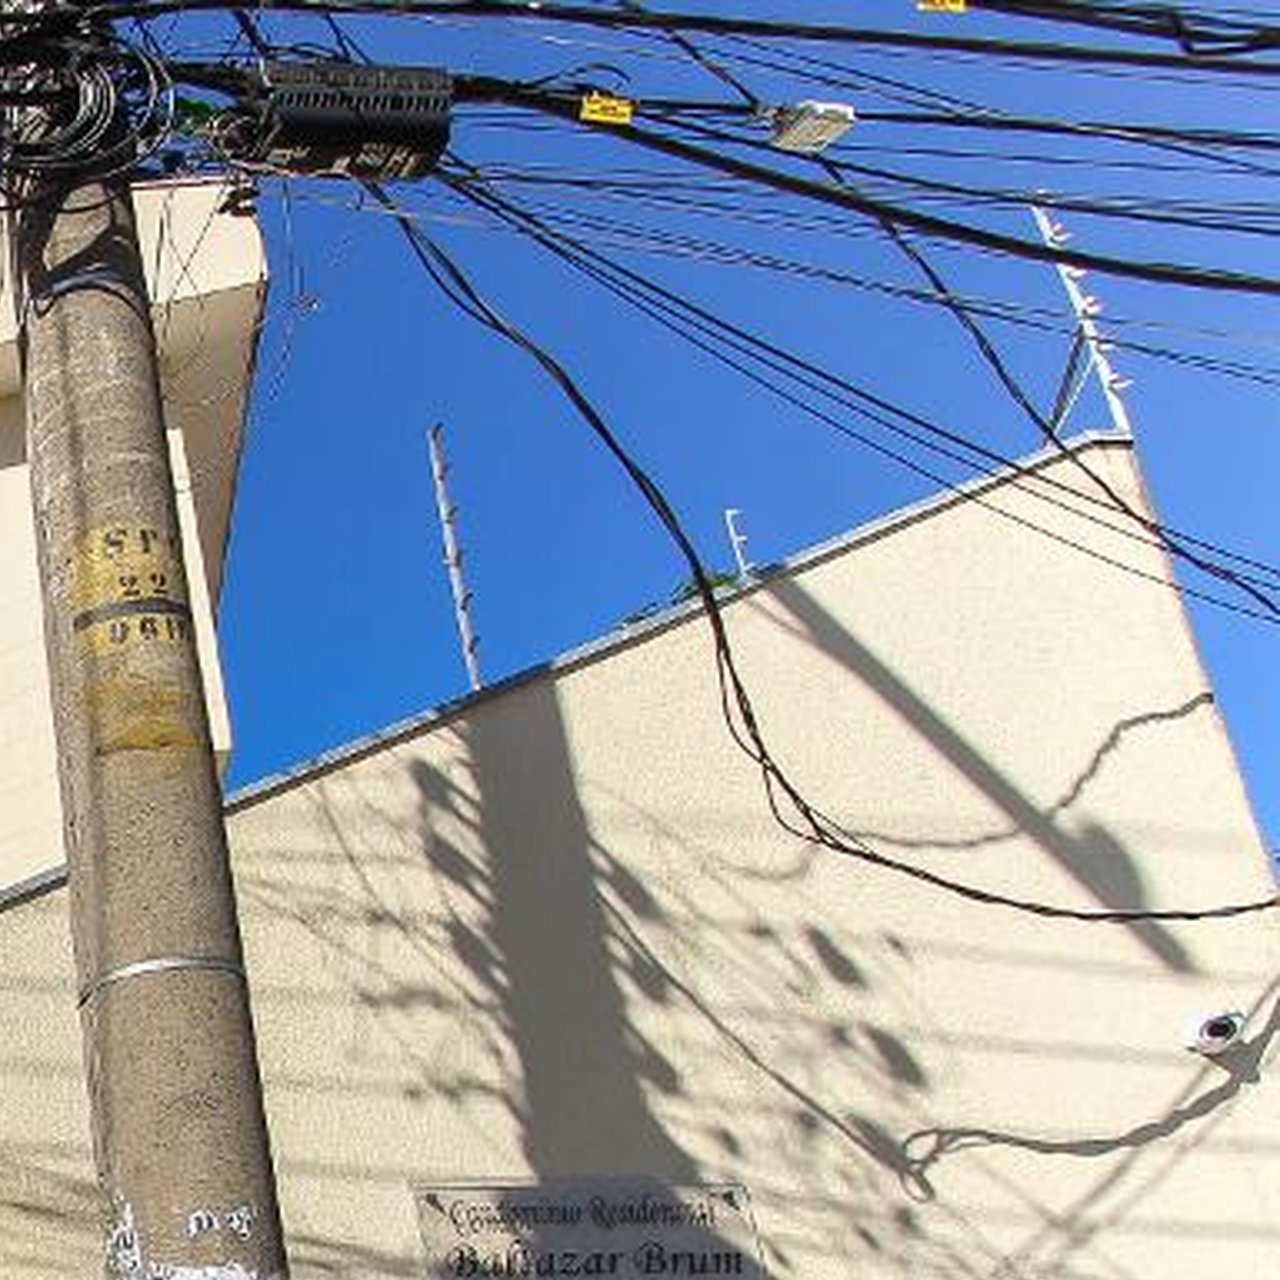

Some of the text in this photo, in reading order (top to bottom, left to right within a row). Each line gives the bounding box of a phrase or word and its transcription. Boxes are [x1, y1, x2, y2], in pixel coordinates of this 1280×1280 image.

[119, 572, 168, 597] 22
[446, 1239, 745, 1280] Baltazar Brum
